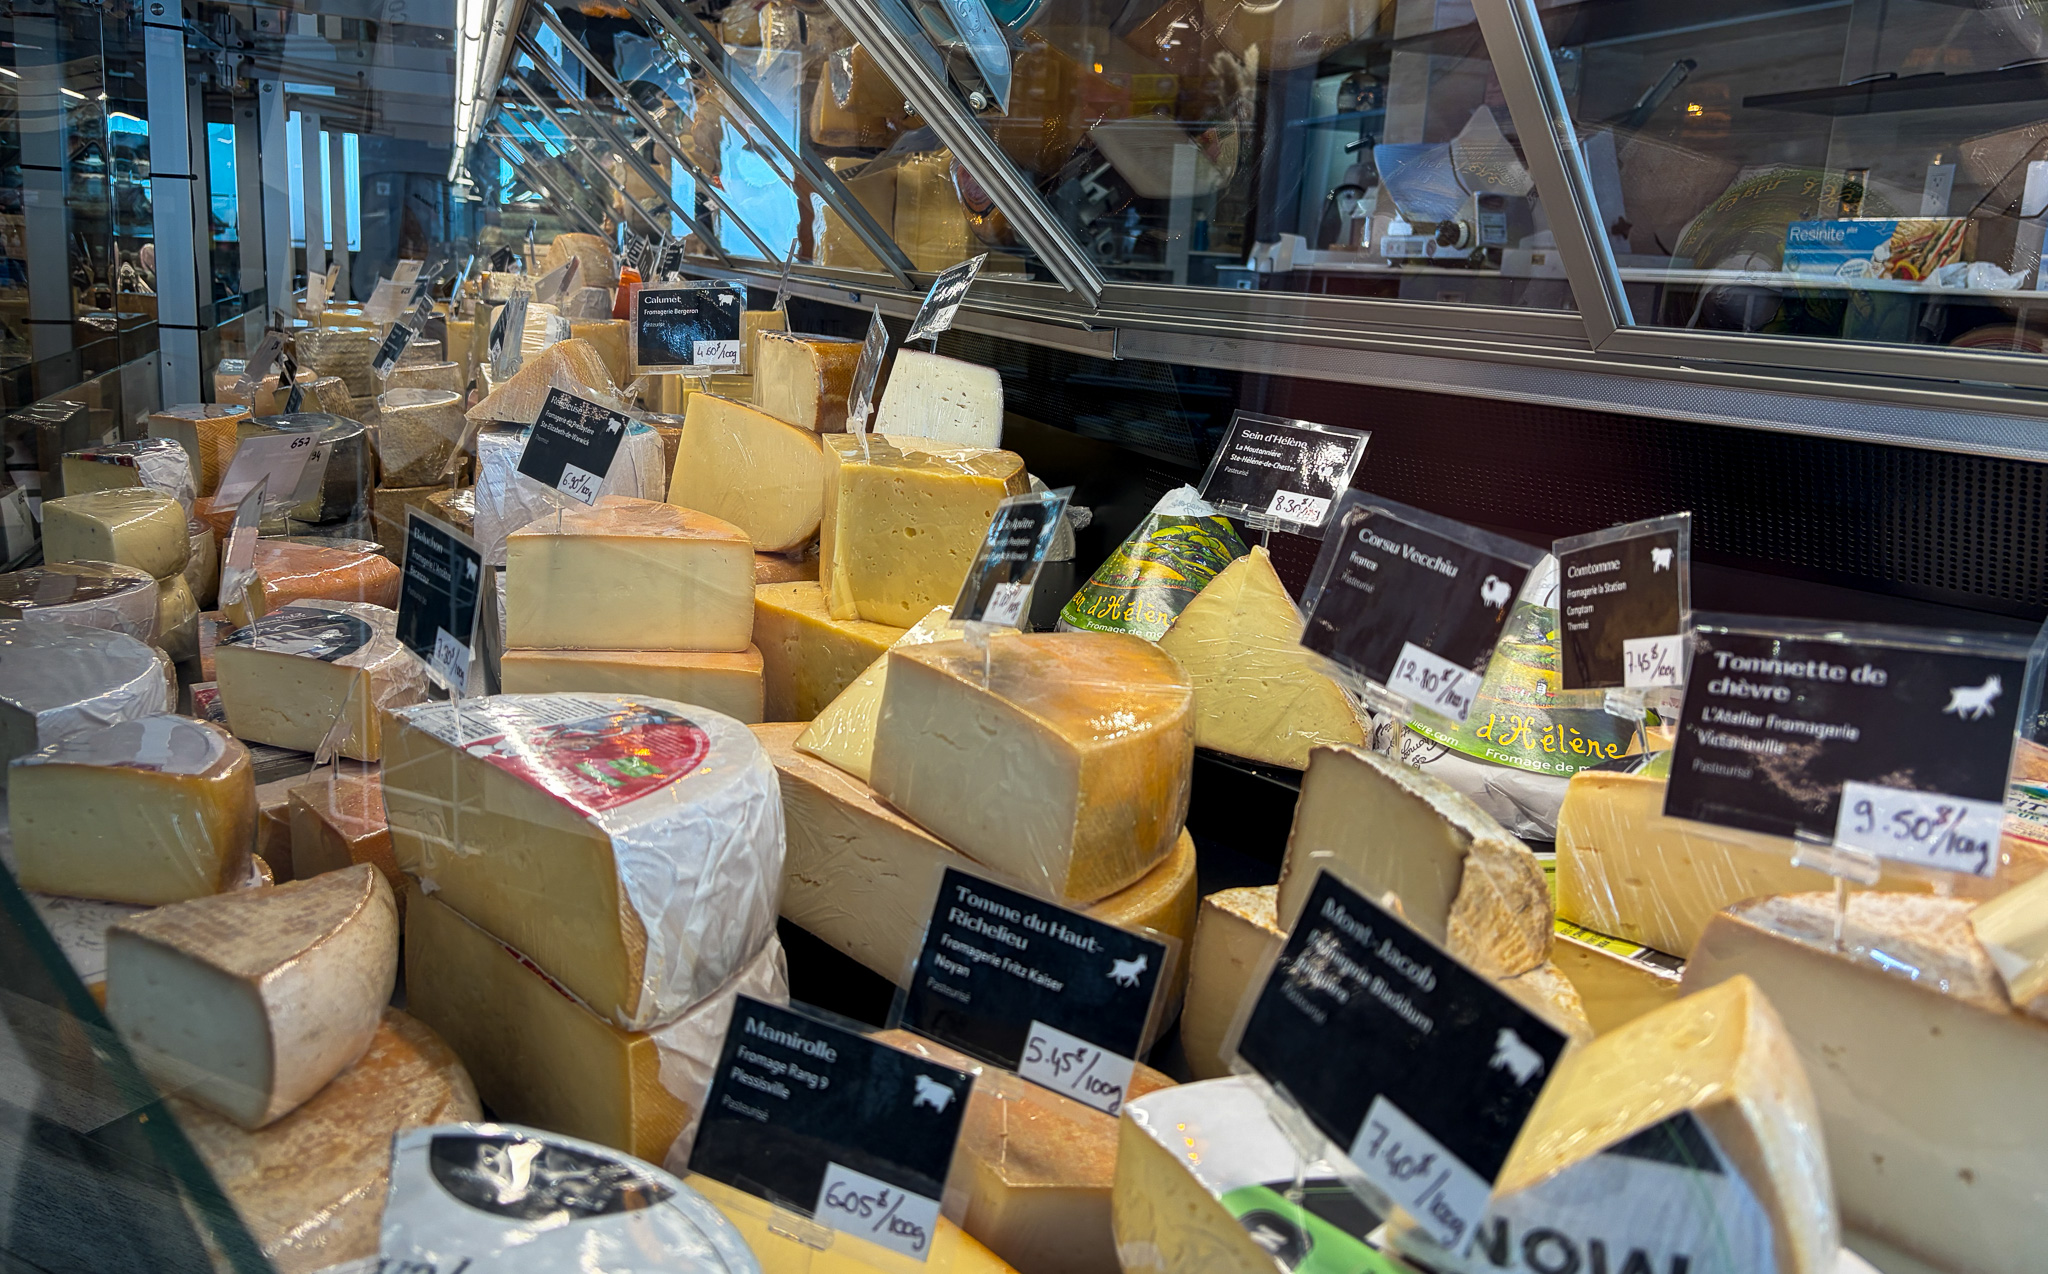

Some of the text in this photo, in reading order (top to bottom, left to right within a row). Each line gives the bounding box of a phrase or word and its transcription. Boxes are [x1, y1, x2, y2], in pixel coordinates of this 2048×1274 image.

[1789, 226, 1845, 242] Resinite
[644, 295, 681, 304] Calumet
[674, 308, 699, 316] Bergeron
[1235, 443, 1282, 458] La Moutonnière
[1241, 429, 1308, 449] Sein d'Hélène
[1230, 453, 1297, 473] Ste-Hélène-de-Chester
[413, 526, 443, 554] Baluchon
[1358, 527, 1459, 578] Corsu Vecchiu
[1349, 551, 1379, 572] France
[1567, 558, 1621, 578] Comtomme
[1072, 587, 1088, 612] ein
[1566, 584, 1597, 600] Fromagerie
[1604, 580, 1627, 594] Station
[1086, 620, 1126, 635] Fromage
[1128, 628, 1142, 636] de
[1713, 650, 1888, 687] Tommette de
[1707, 675, 1791, 703] chèvre
[1701, 705, 1765, 728] L'Atelier
[1476, 712, 1626, 760] d'Hélène
[1697, 728, 1788, 755] Victoriaville
[1485, 748, 1551, 771] Fromage
[1555, 760, 1574, 773] de
[948, 906, 1028, 951] Richelieu
[956, 884, 1105, 954] Tomme du Haut-
[934, 951, 971, 979] Noyan
[940, 932, 1064, 994] Fromagerie Fritz Kaiser
[926, 976, 972, 1005] Pasteurisé
[744, 1016, 838, 1063] Mamirolle
[737, 1045, 830, 1090] Fromage Rang 9
[1025, 1036, 1123, 1113] 5.45$/100g
[729, 1066, 791, 1100] Plessisville
[721, 1094, 770, 1123] Pasteurisé
